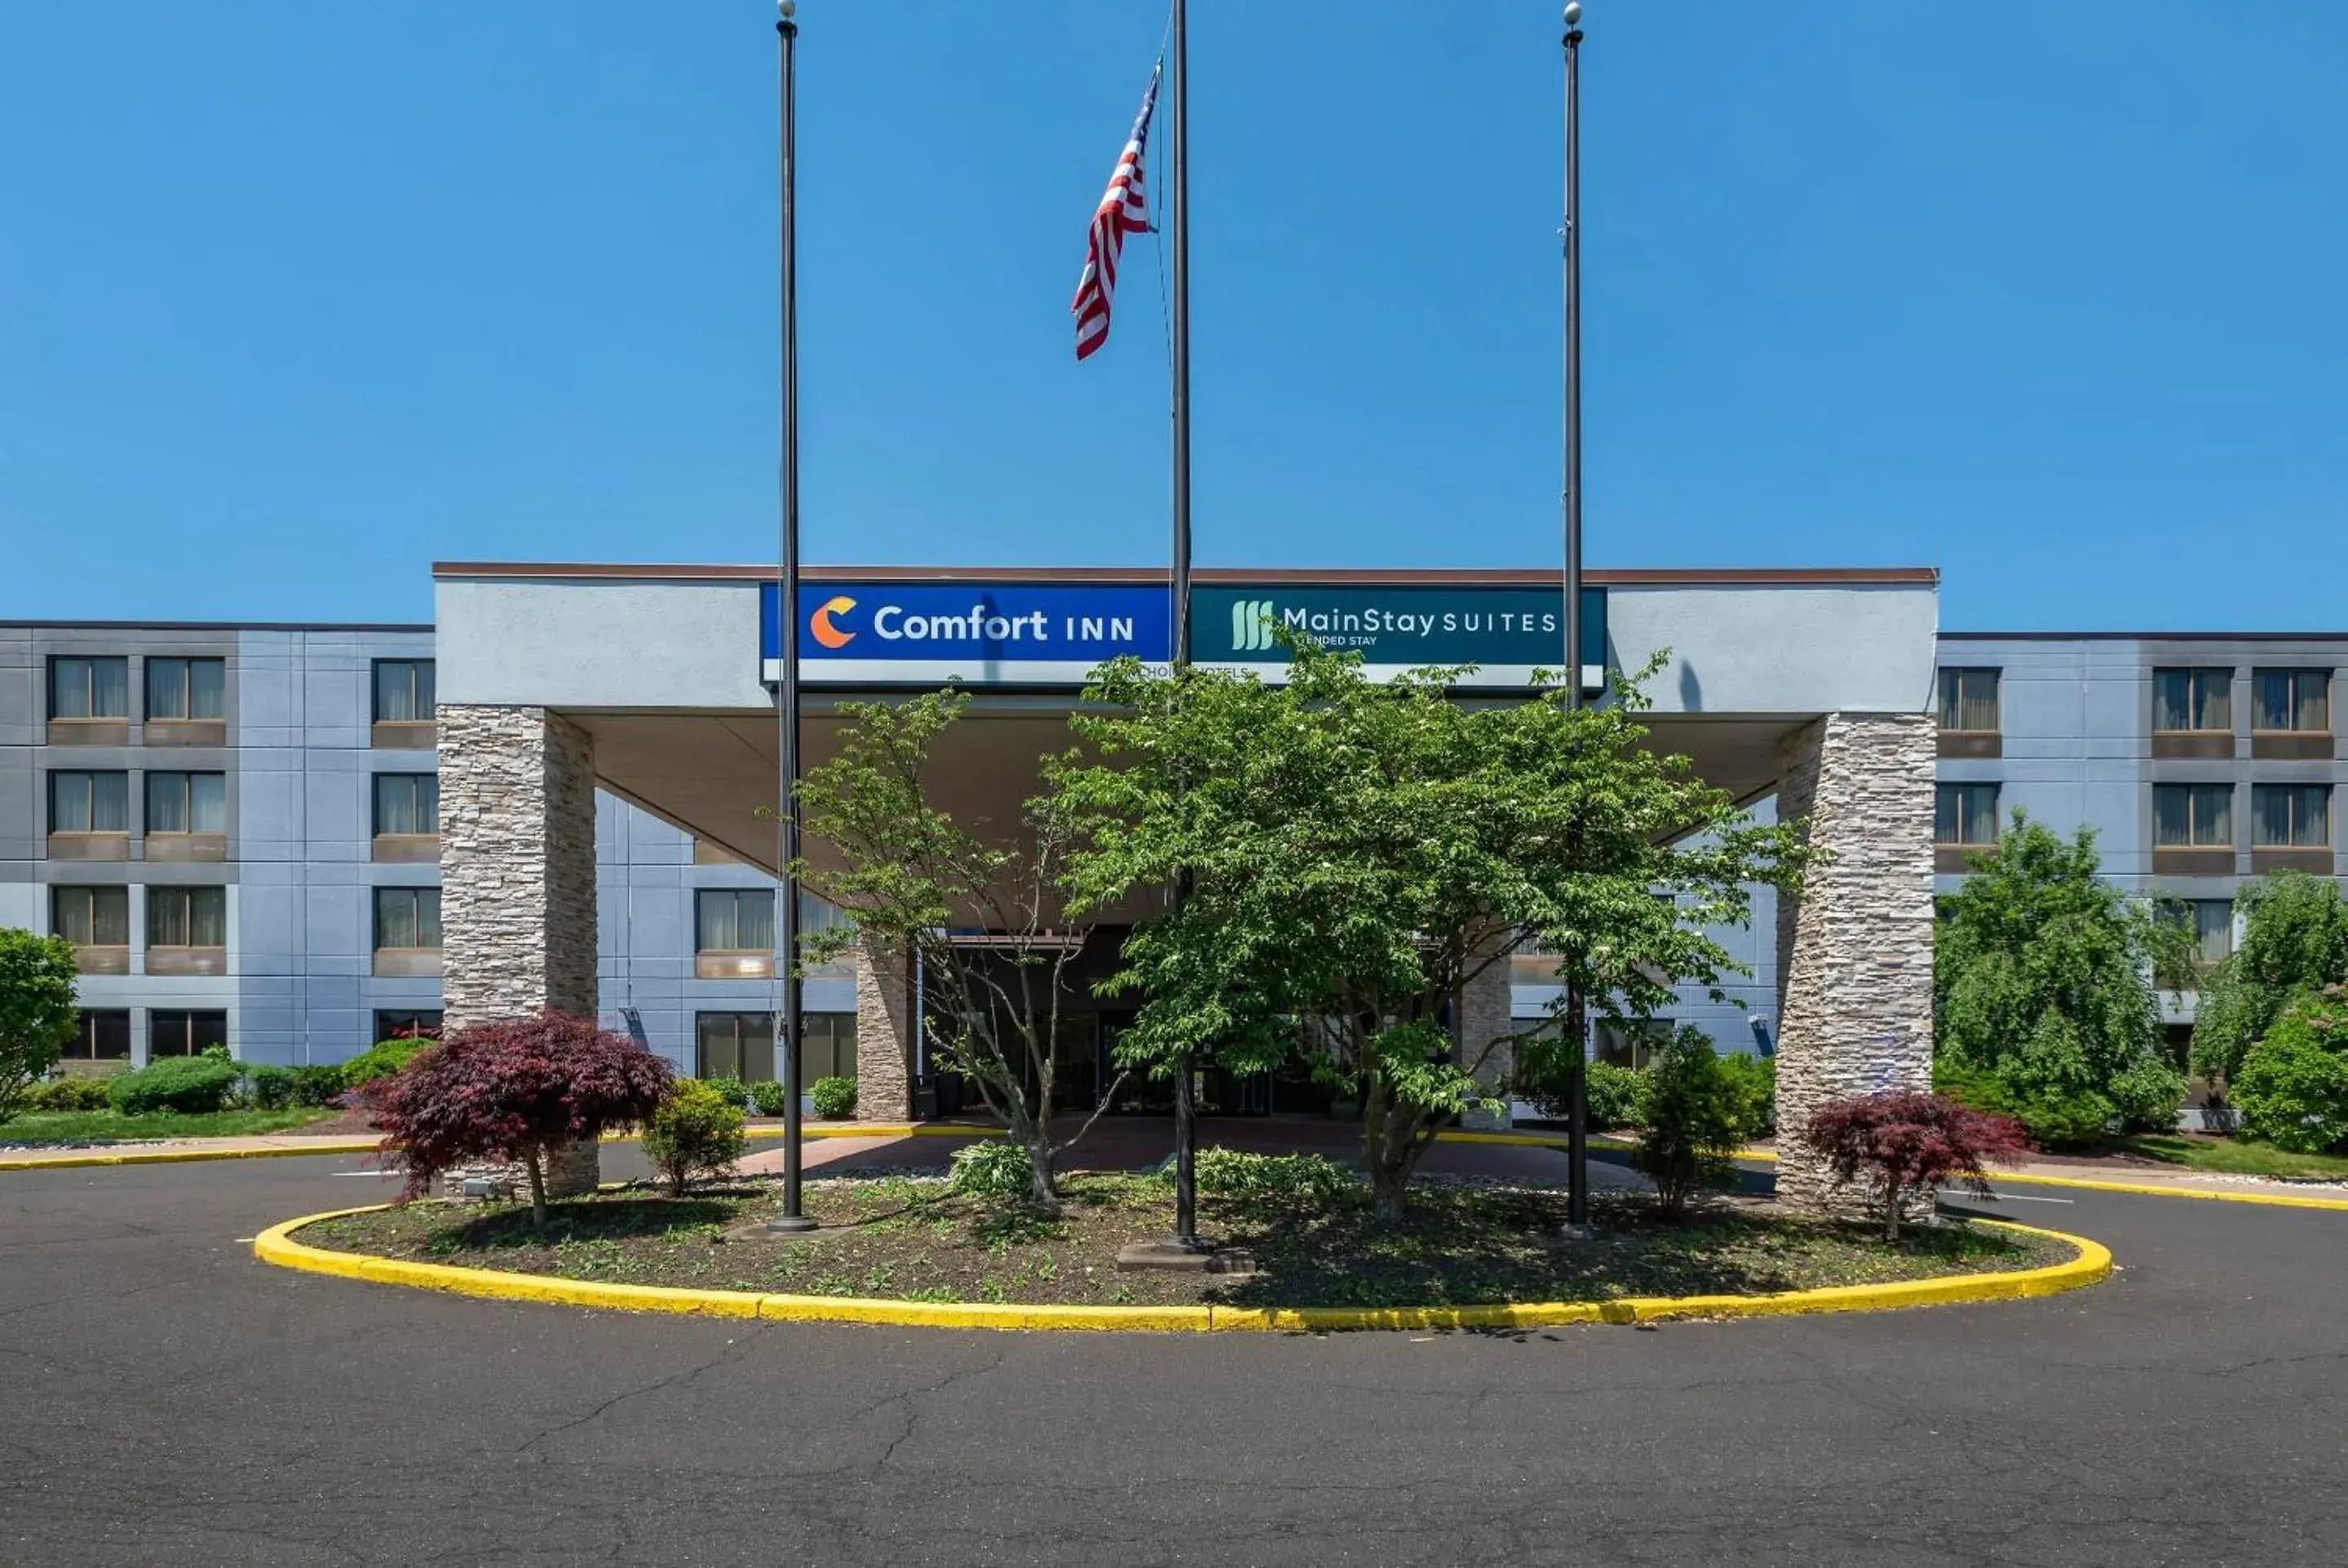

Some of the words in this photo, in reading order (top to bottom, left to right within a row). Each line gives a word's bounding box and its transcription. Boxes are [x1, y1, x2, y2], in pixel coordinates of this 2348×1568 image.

[873, 605, 1048, 641] Comfort
[1066, 617, 1133, 641] INN
[1284, 607, 1435, 638] MainStay
[1443, 613, 1556, 632] SUITES
[1294, 636, 1346, 646] ENDED
[1349, 636, 1377, 646] STAY
